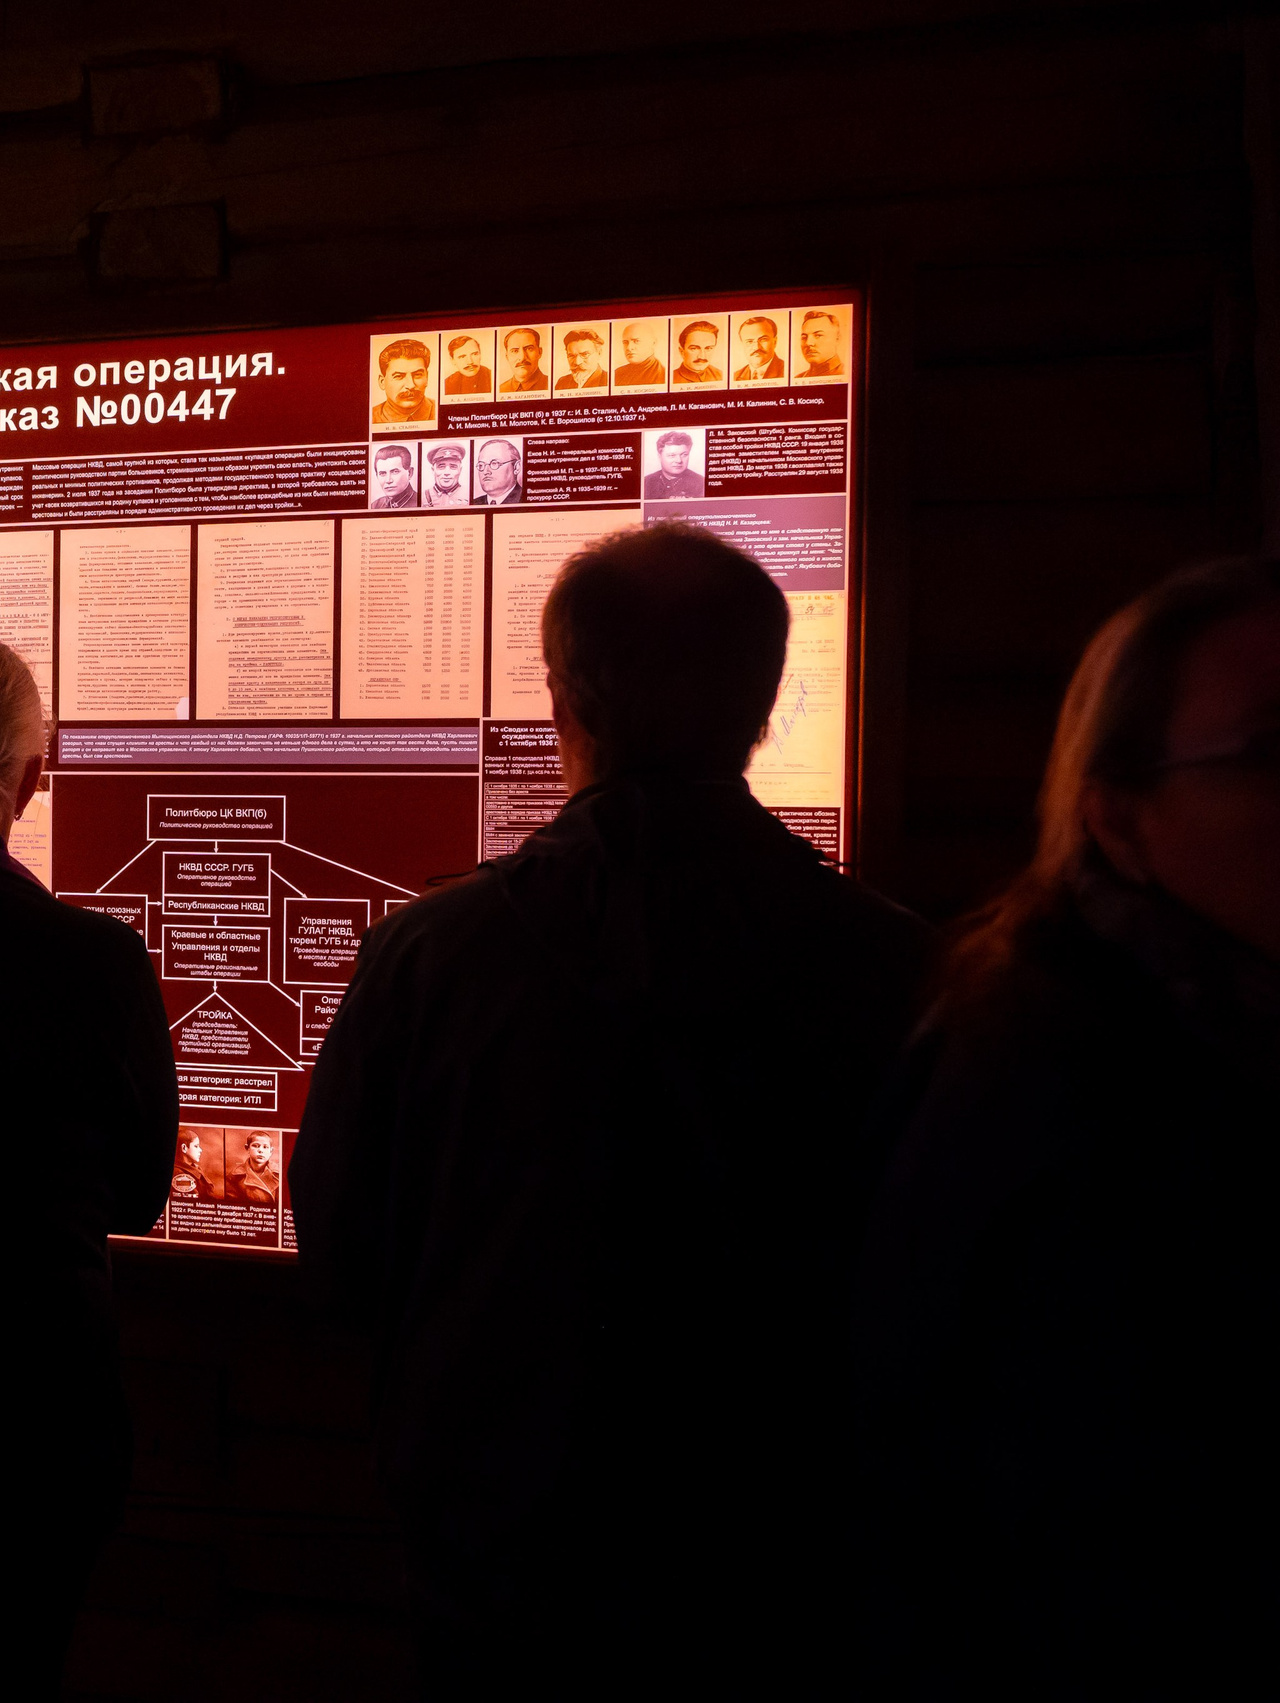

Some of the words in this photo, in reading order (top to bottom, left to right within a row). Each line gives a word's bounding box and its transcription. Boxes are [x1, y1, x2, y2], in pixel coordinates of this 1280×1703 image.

[74, 352, 284, 390] операция.
[76, 388, 237, 428] №00447
[471, 414, 507, 422] Политбюро
[535, 410, 544, 418] (б)
[638, 405, 668, 413] Андреев,
[166, 808, 217, 818] Политбюро
[220, 808, 233, 818] ЦК
[236, 808, 266, 819] ВКП(б)
[179, 863, 202, 872] НКВД
[204, 863, 229, 871] СССР.
[232, 863, 254, 871] ГУГБ
[168, 900, 238, 910] Республиканские
[241, 902, 264, 911] НКВД
[301, 916, 352, 928] Управления
[171, 930, 206, 939] Краевые
[216, 931, 260, 940] областные
[298, 926, 326, 937] ГУЛАГ
[328, 927, 354, 938] НКВД,
[289, 937, 316, 945] тюрем
[319, 936, 341, 945] ГУГБ
[172, 942, 220, 954] Управления
[230, 945, 260, 953] отделы
[204, 952, 228, 963] НКВД
[197, 1010, 233, 1020] ТРОЙКА
[190, 1076, 232, 1085] категория:
[200, 1094, 242, 1104] категория:
[244, 1096, 262, 1104] ИТЛ
